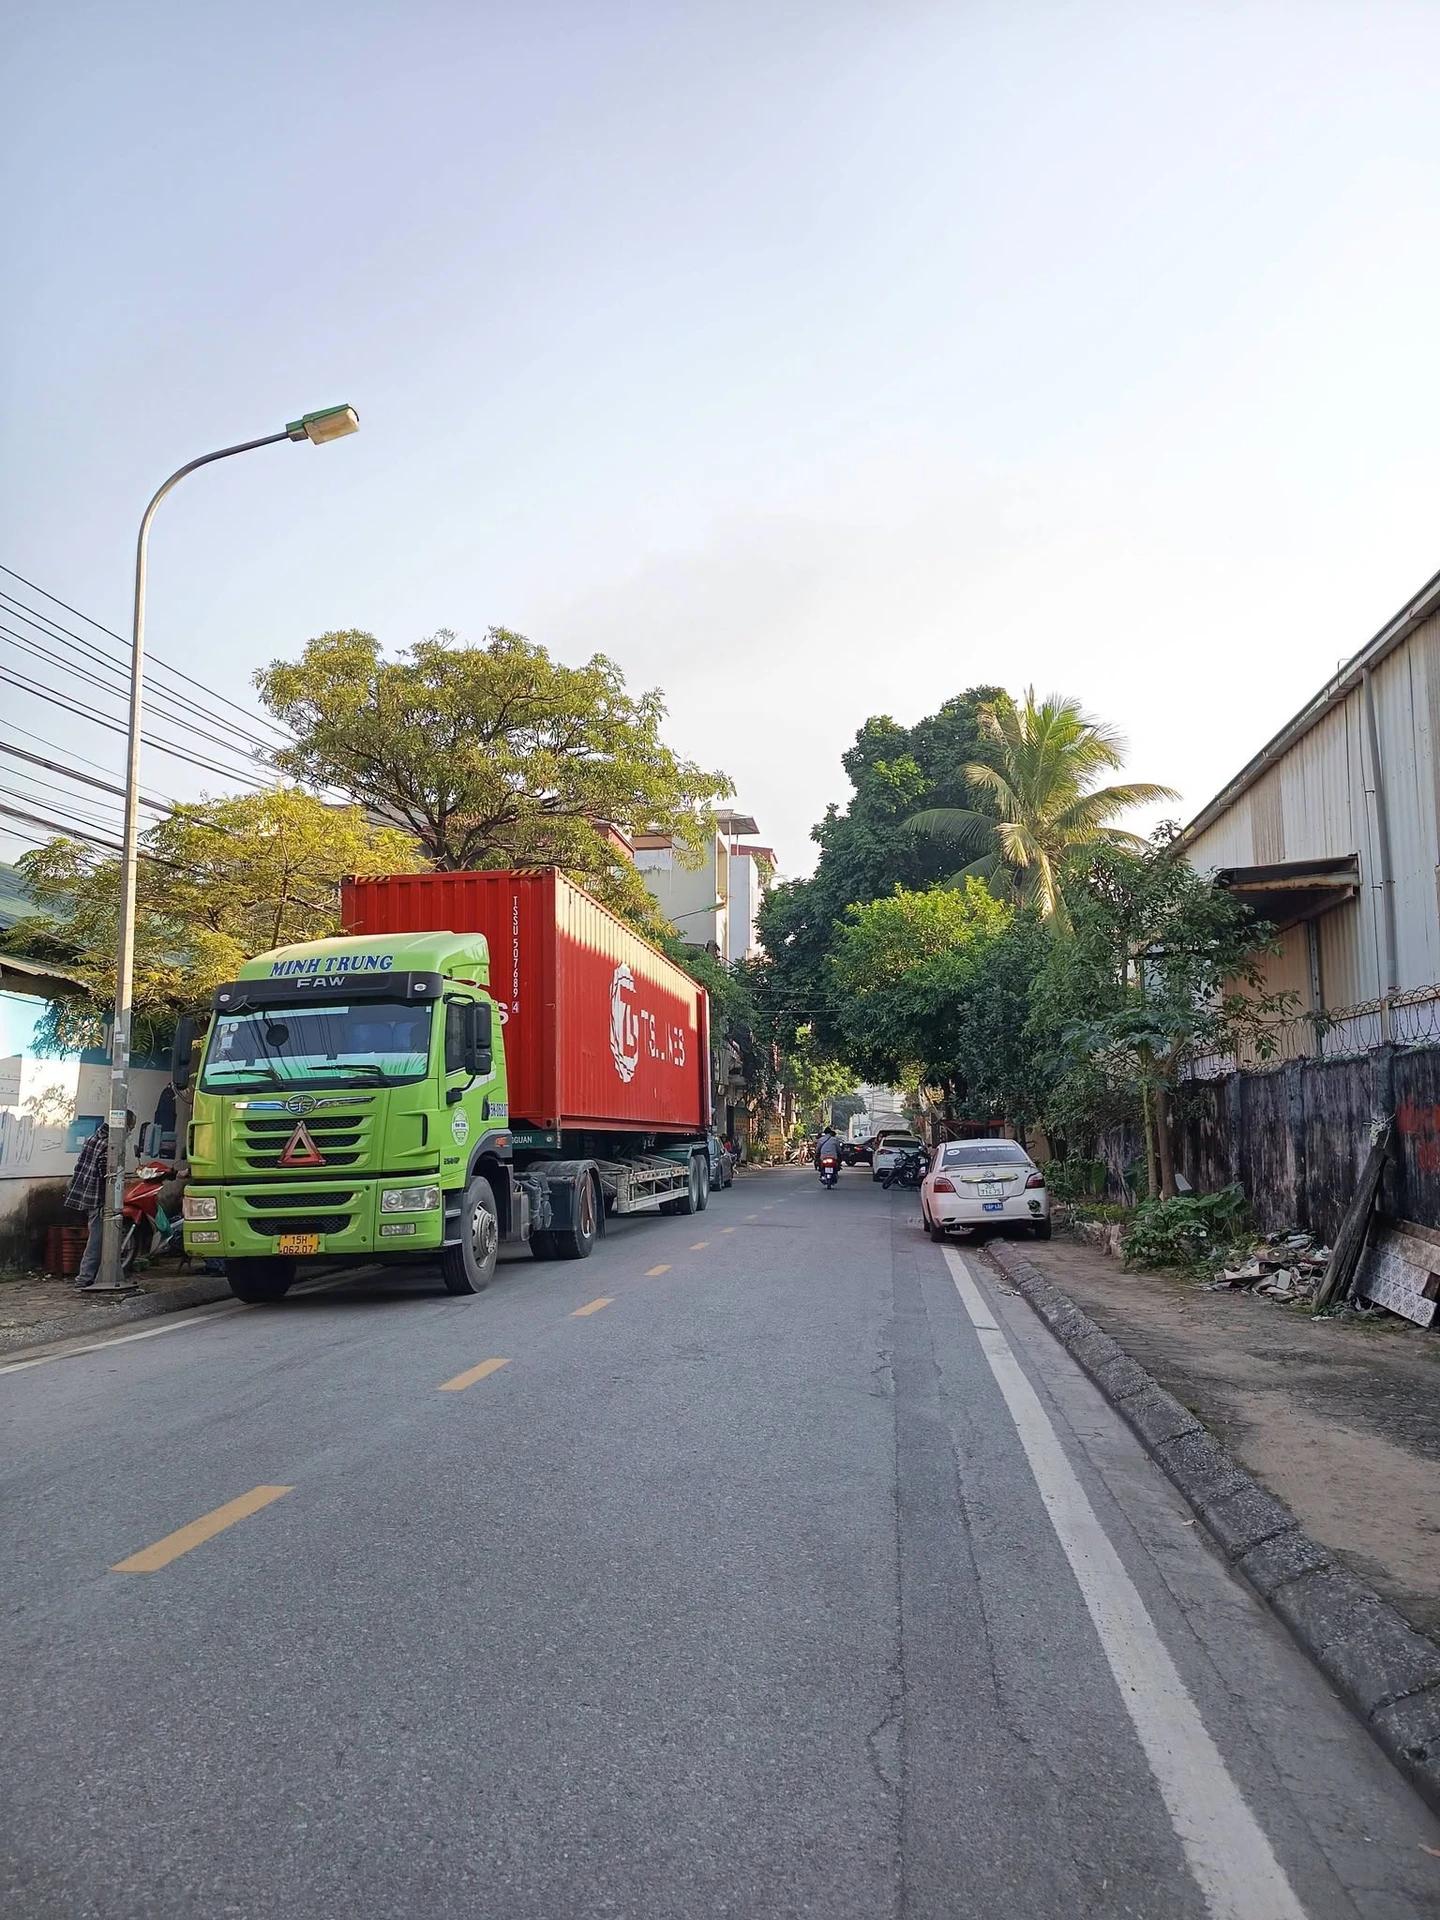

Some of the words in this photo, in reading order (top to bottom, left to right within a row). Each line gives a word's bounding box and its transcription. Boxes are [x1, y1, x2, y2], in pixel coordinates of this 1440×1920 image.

[270, 958, 322, 976] MINH
[325, 956, 393, 972] TRUNG
[296, 976, 346, 988] FAW
[512, 1001, 519, 1013] 4
[291, 1236, 307, 1244] 15H
[283, 1244, 313, 1254] 062.07
